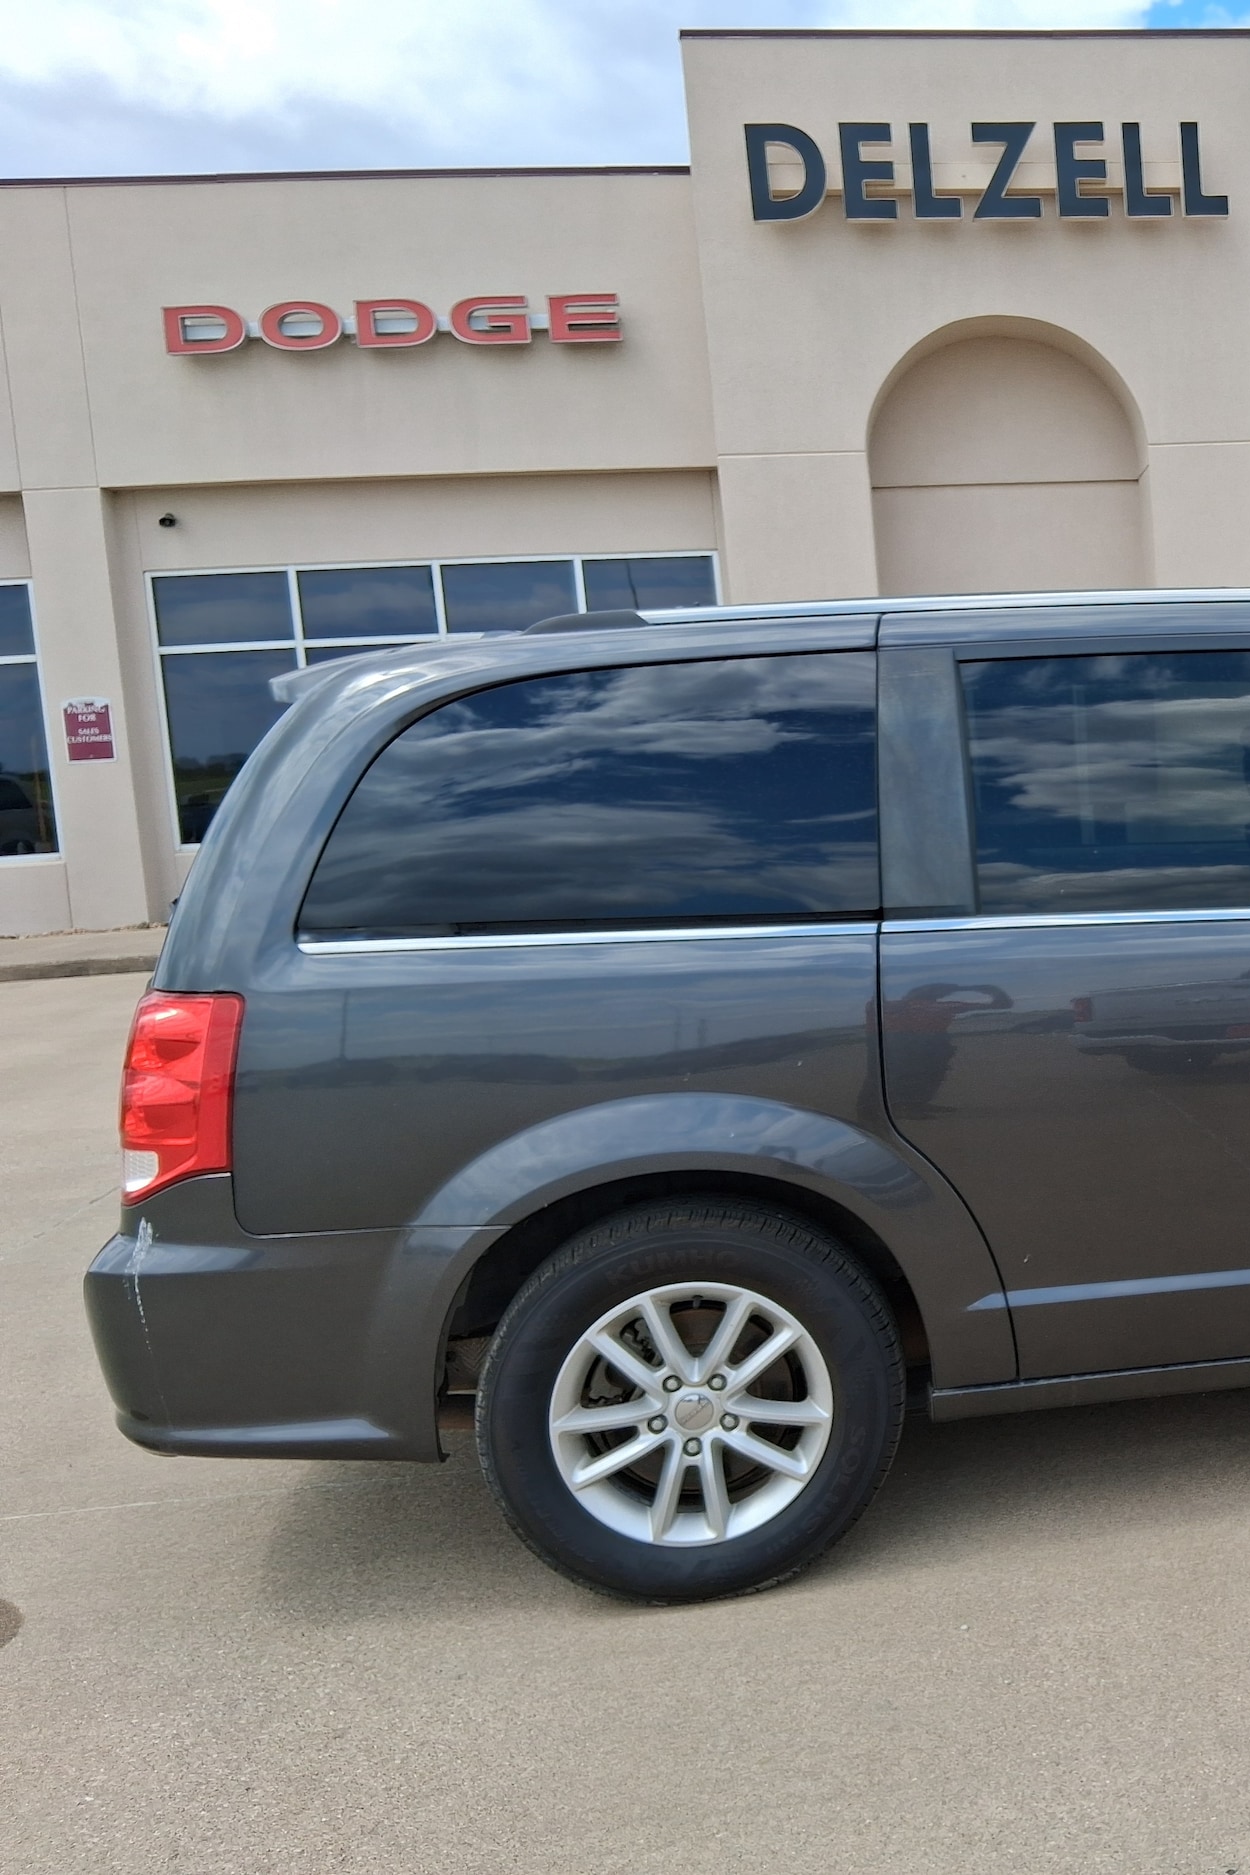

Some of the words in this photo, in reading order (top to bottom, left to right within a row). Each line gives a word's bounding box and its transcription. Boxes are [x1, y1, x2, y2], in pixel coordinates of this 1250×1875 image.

[743, 120, 1231, 222] DELZELL
[161, 293, 624, 355] DODGE
[67, 704, 106, 714] PARKING
[78, 713, 97, 722] FOR
[78, 727, 100, 735] SALES
[66, 734, 112, 744] CUSTOMERS
[605, 1249, 745, 1286] KUMHO
